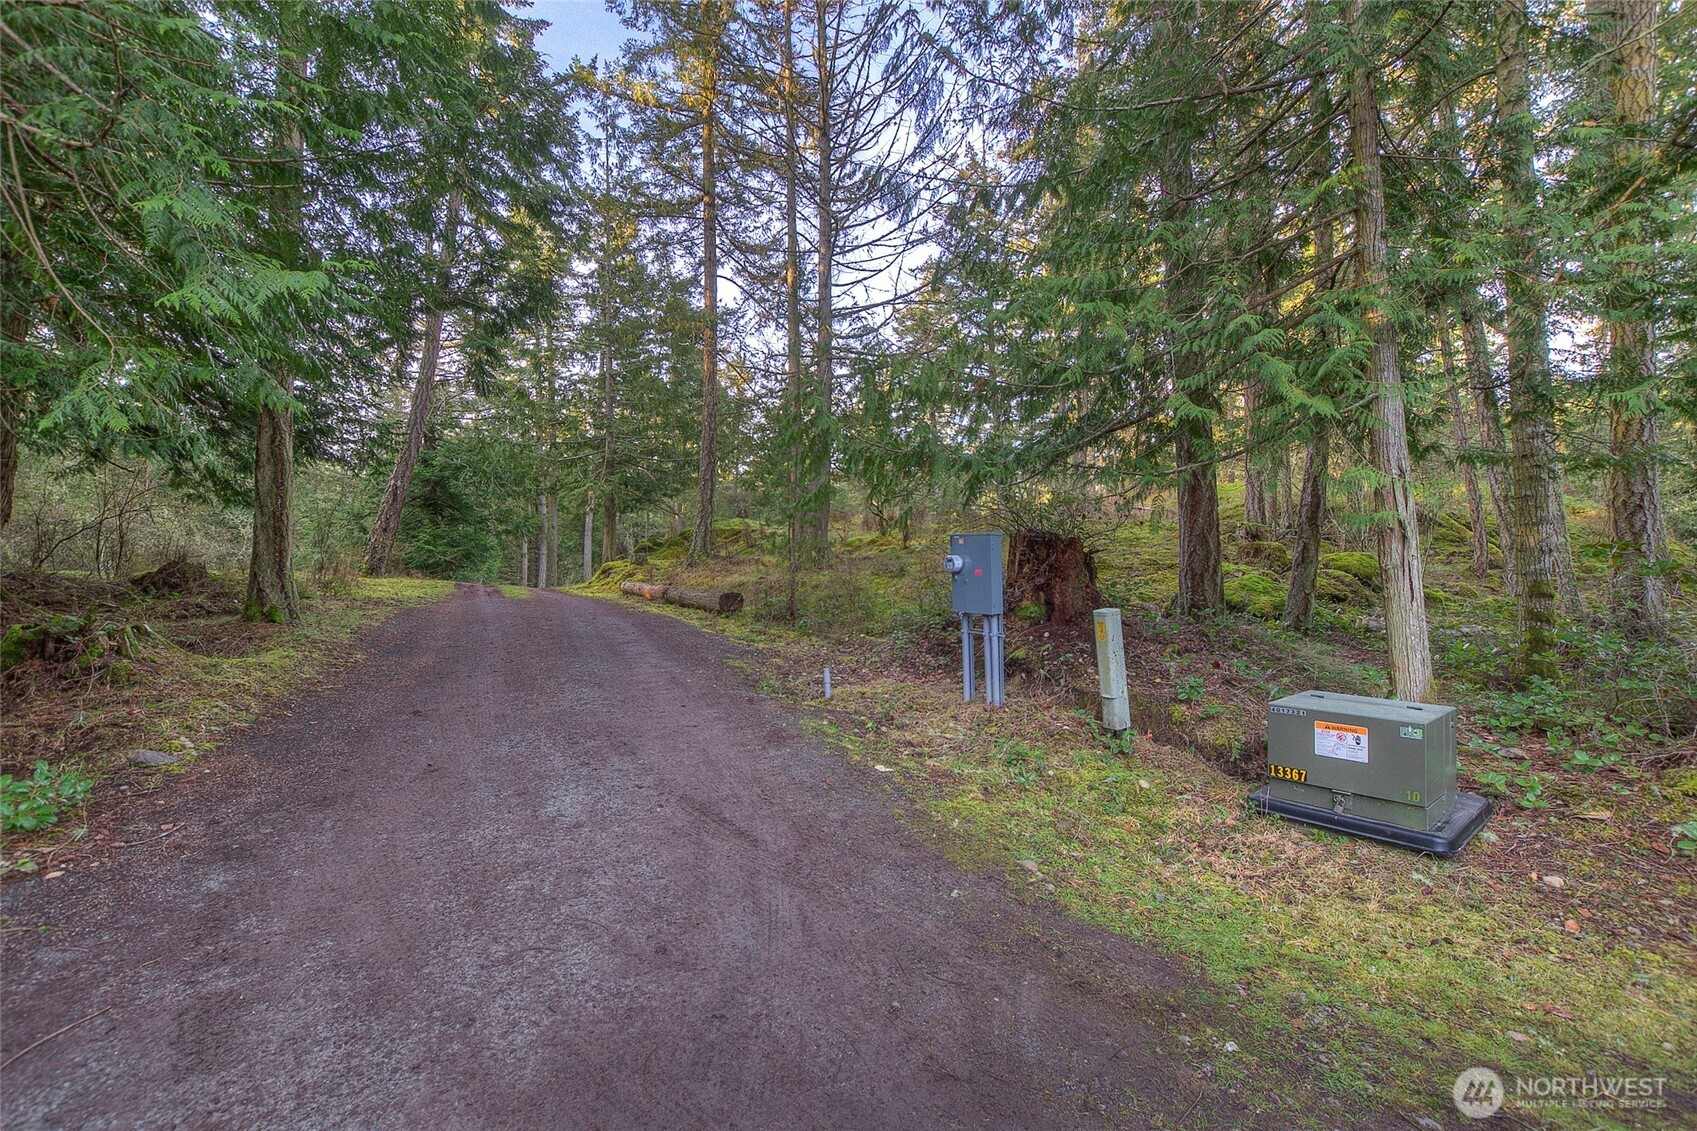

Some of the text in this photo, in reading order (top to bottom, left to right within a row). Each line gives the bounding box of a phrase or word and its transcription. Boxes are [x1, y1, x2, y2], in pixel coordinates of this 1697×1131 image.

[1271, 707, 1306, 716] 4017321
[1331, 725, 1358, 734] WARNING
[1269, 764, 1307, 782] 13367
[1406, 790, 1420, 803] 10
